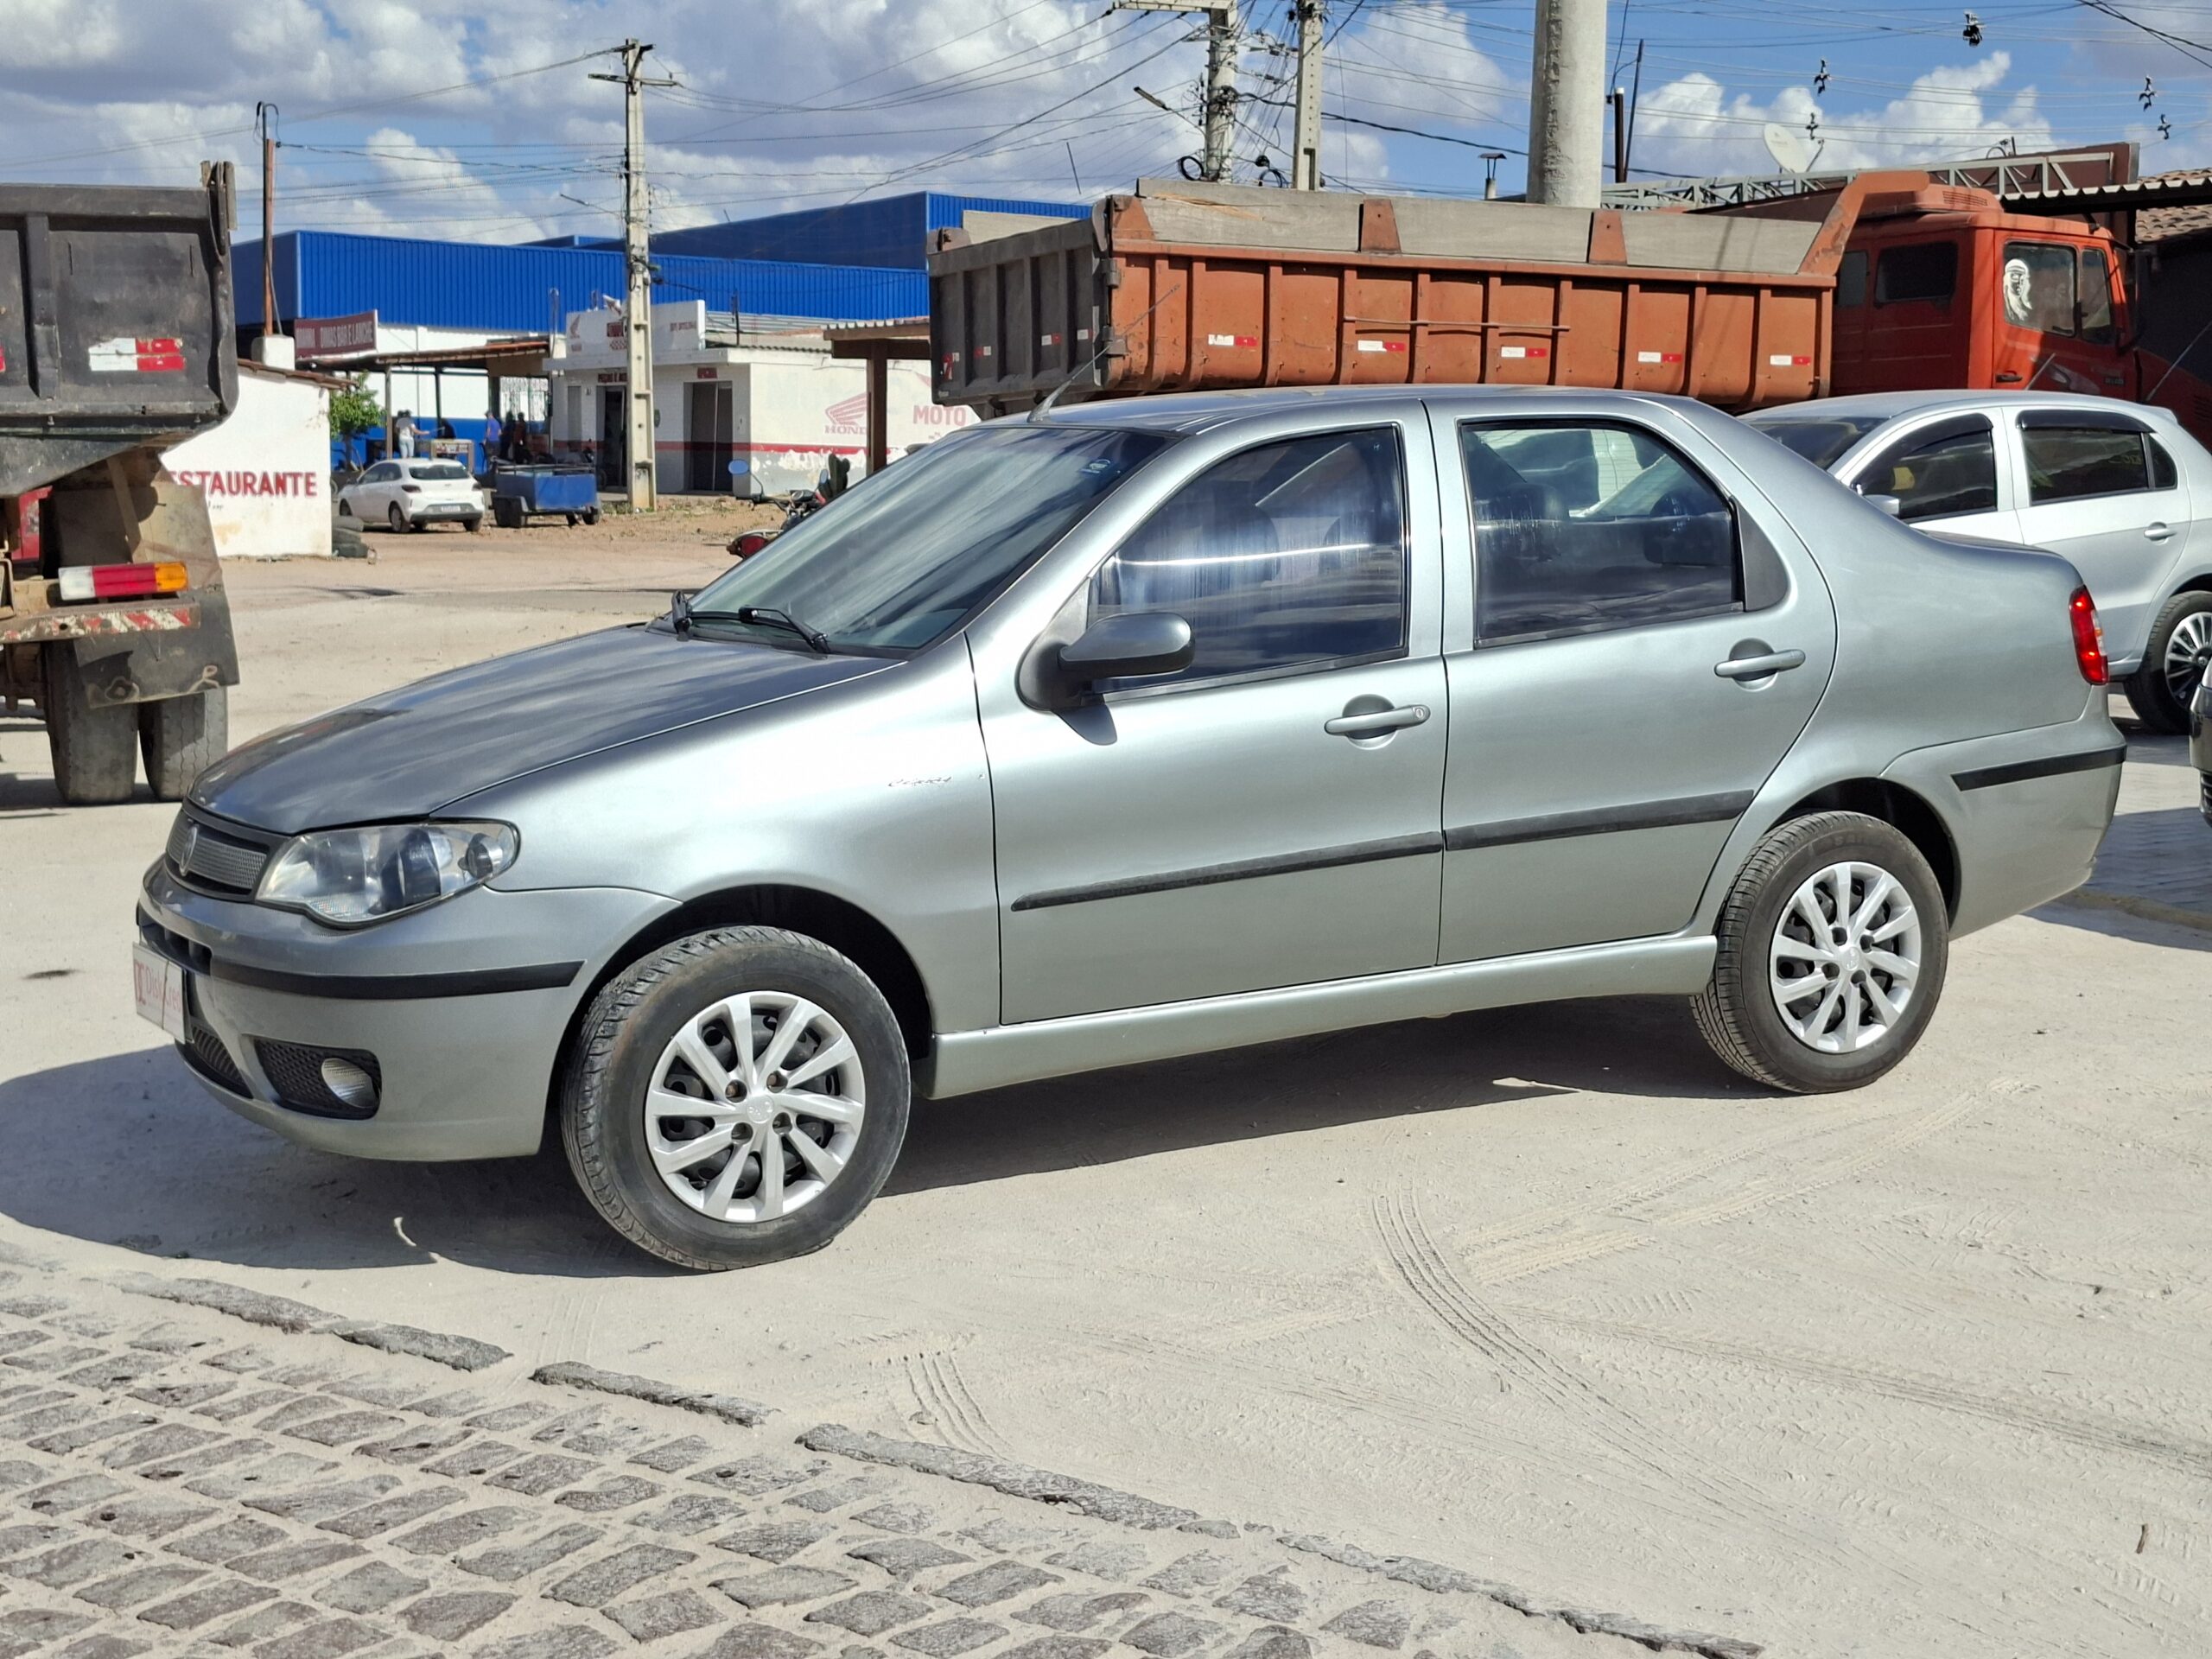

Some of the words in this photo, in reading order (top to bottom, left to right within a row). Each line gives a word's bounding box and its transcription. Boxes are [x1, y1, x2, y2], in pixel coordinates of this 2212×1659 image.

[913, 404, 967, 426] MOTO
[824, 424, 868, 435] HOND
[169, 471, 317, 496] STAURANTE
